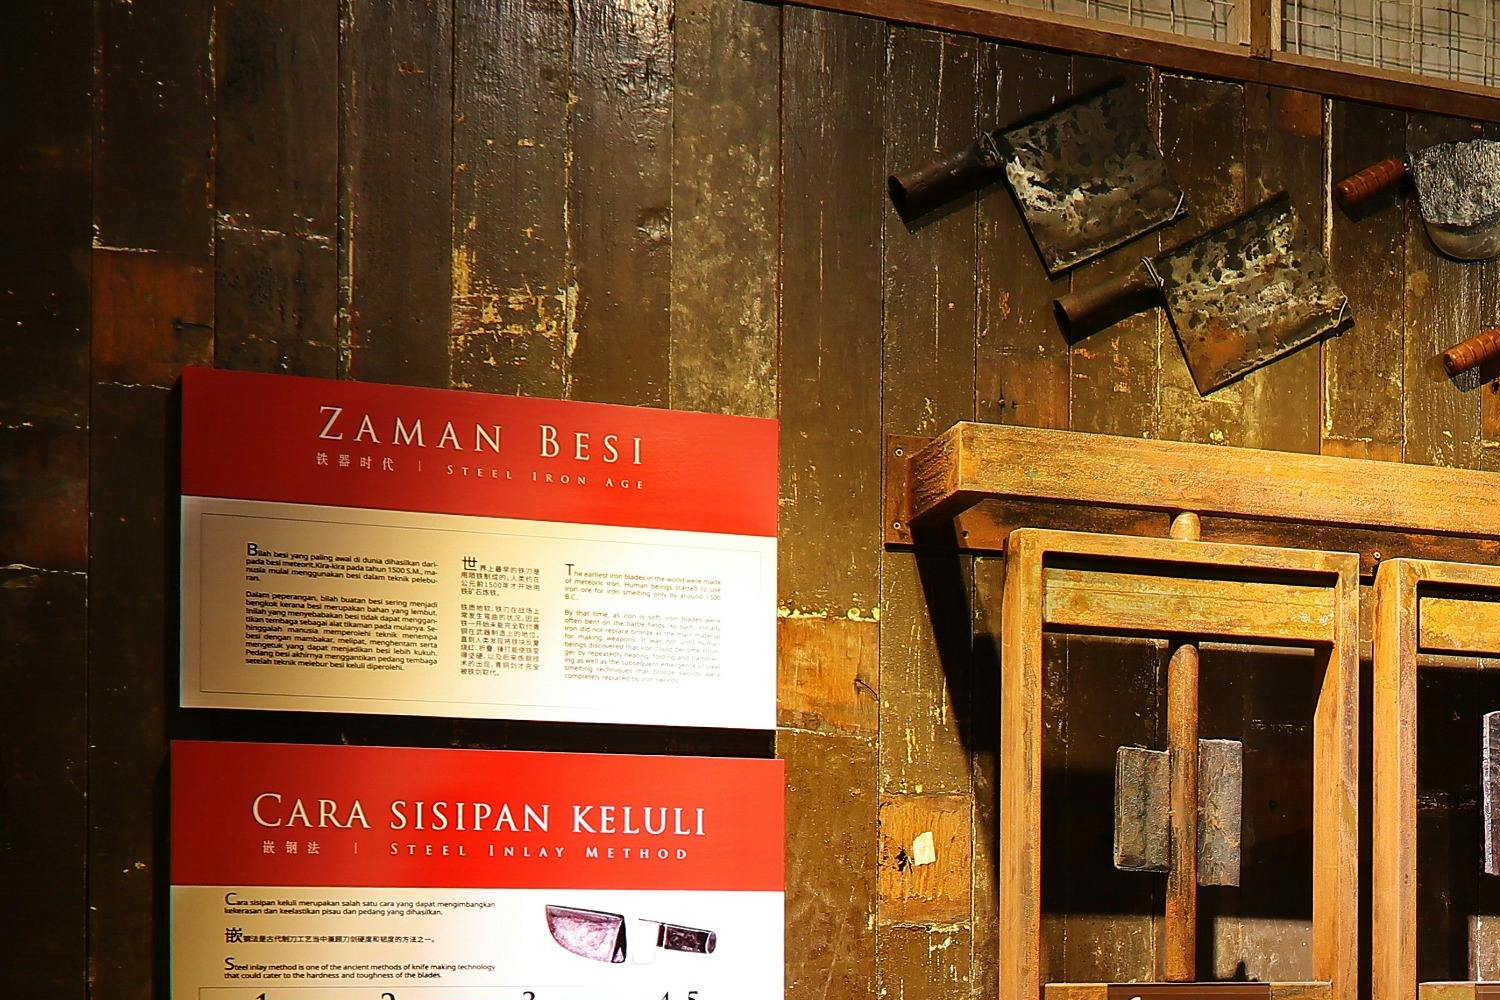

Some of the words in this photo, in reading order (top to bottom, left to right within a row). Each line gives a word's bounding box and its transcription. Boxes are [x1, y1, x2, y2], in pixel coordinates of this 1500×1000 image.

[318, 405, 503, 455] ZAMAN
[539, 424, 644, 466] BESI
[316, 452, 395, 472] 铁器时代
[446, 464, 513, 480] STEEL
[532, 471, 587, 486] IRON
[605, 477, 645, 491] AGE
[246, 558, 264, 567] pada
[265, 559, 280, 567] besi
[346, 564, 364, 573] pada
[365, 565, 386, 573] tahun
[388, 566, 405, 574] 1500
[246, 590, 269, 599] Dalam
[320, 594, 338, 602] bilah
[340, 595, 365, 604] buatan
[368, 597, 383, 605] besi
[385, 598, 407, 607] sering
[409, 599, 437, 609] menjadi
[329, 660, 344, 668] besi
[252, 793, 370, 830] CARA
[390, 800, 550, 832] SISIPAN
[572, 806, 706, 836] KELULI
[390, 843, 466, 857] STEEL
[488, 844, 564, 860] INLAY
[585, 846, 688, 861] METHOD
[225, 893, 248, 906] Cara
[249, 898, 275, 908] sisipan
[277, 898, 296, 906] keluli
[298, 899, 339, 908] merupakan
[341, 899, 360, 907] salah
[362, 899, 377, 907] satu
[396, 901, 413, 909] yang
[415, 900, 435, 909] dapat
[437, 900, 495, 910] mengimbangkan
[224, 906, 262, 914] kekerasan
[263, 906, 277, 914] dan
[321, 907, 341, 916] pisau
[342, 907, 356, 915] dan
[358, 907, 385, 917] pedang
[387, 909, 404, 917] yang
[225, 958, 248, 970] Steel
[249, 963, 266, 972] inlay
[430, 963, 456, 972] making
[457, 963, 495, 972] technology
[356, 971, 393, 980] toughness
